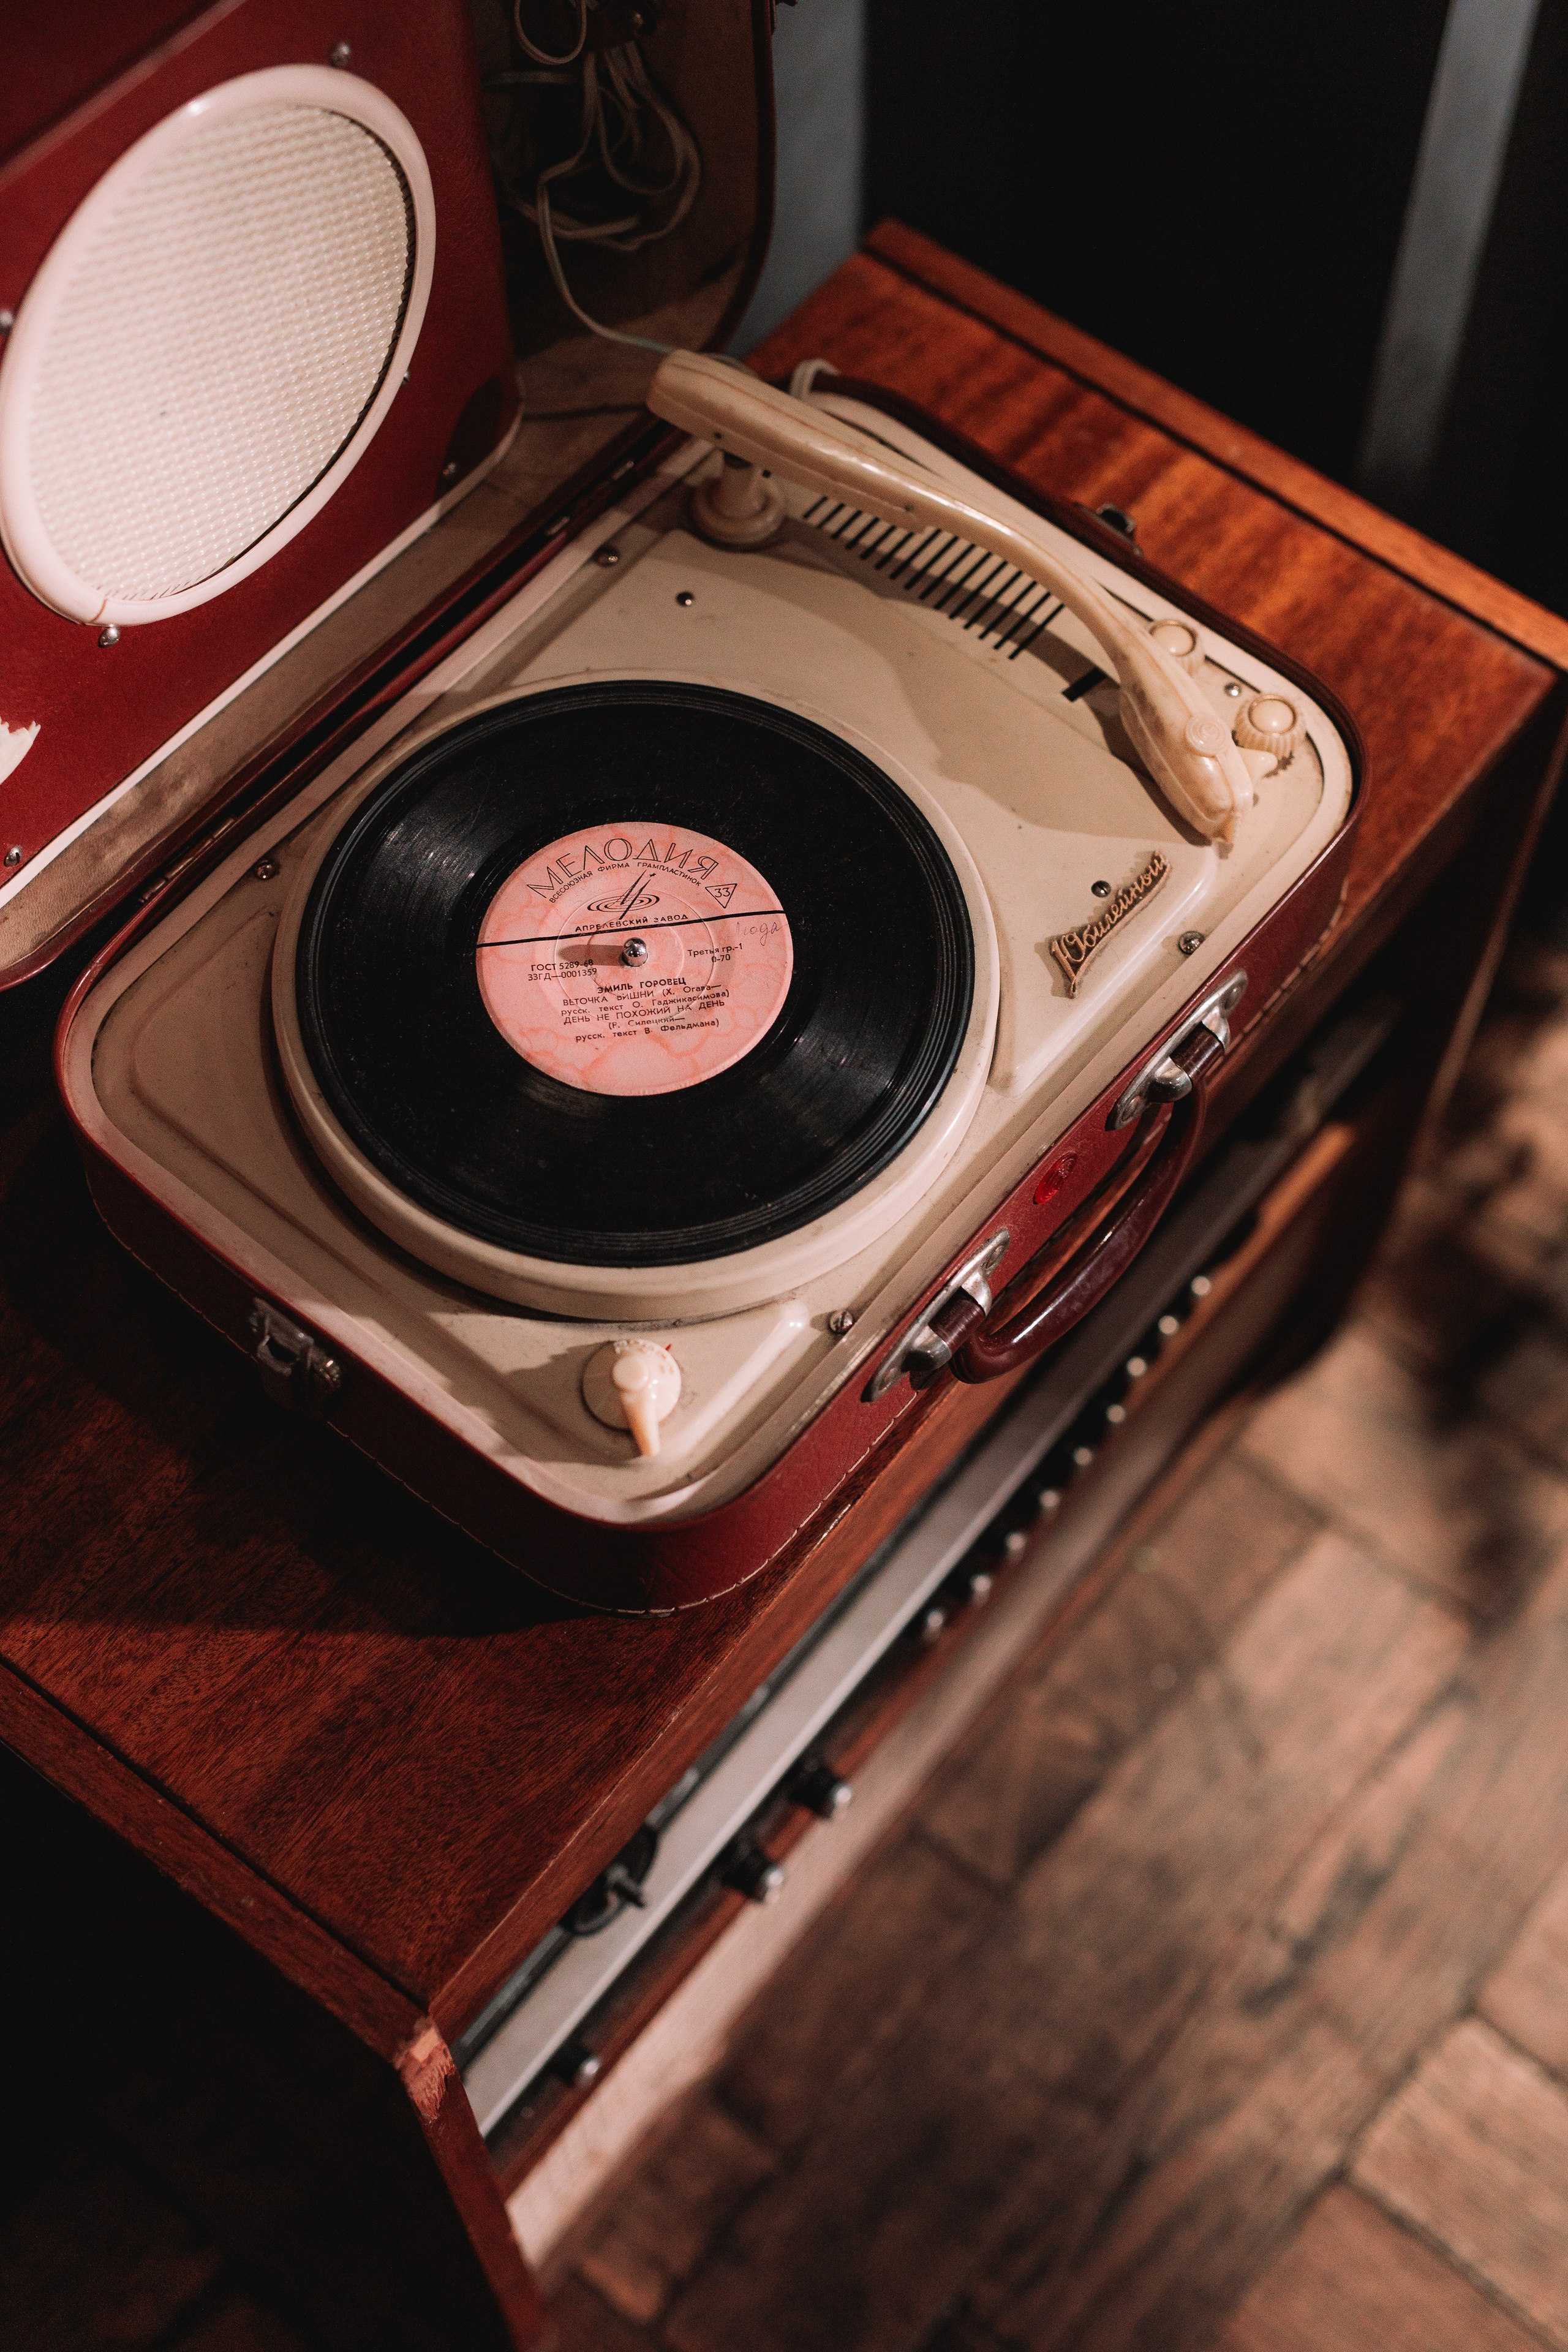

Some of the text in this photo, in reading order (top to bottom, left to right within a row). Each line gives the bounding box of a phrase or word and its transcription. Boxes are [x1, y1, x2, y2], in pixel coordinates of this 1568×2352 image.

[526, 838, 719, 899] МЕЛОДИЯ
[549, 862, 701, 903] ВСЕСОЮЗНАЯ ФИРМА ГРАМПЛАСТИНОК
[714, 887, 731, 898] 33
[575, 914, 688, 932] АПРЕЛЕВСКИЙ ЗАВОД
[687, 948, 719, 957] Третья
[711, 954, 731, 963] 0-70
[530, 959, 594, 971] ГОСТ 5289-68
[597, 977, 686, 994] ЭМИЛЬ ГОРОВЕЦ
[563, 996, 608, 1006] ВЕТОЧКА
[652, 989, 729, 1006] Гаджикасимова)
[564, 1016, 590, 1025] ДЕНЬ
[616, 1006, 671, 1019] ПОХОЖИЙ
[698, 1000, 725, 1010] ДЕНЬ
[576, 1033, 605, 1042] русск.
[660, 1018, 719, 1031] Фельдмана)
